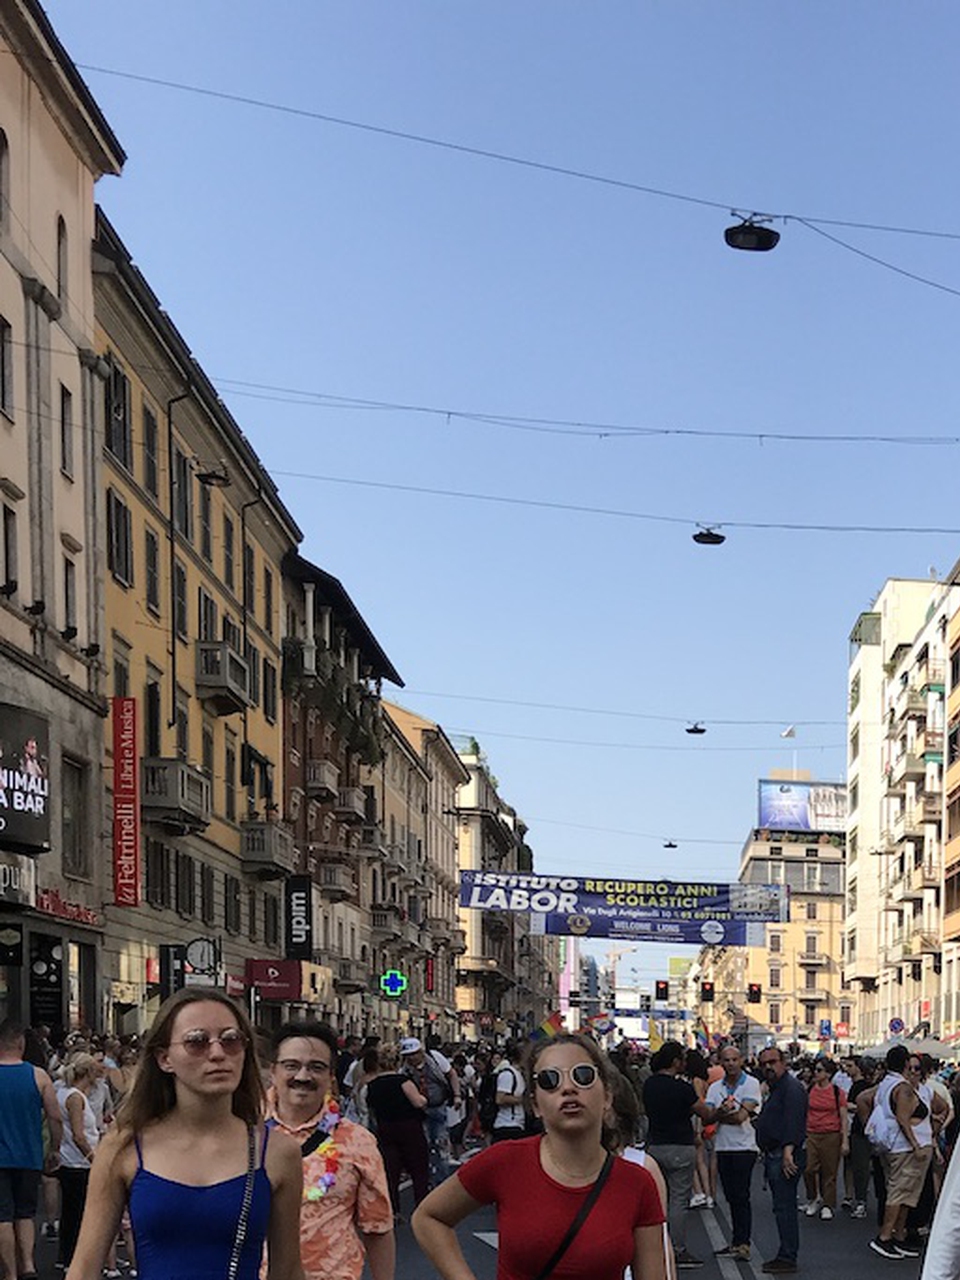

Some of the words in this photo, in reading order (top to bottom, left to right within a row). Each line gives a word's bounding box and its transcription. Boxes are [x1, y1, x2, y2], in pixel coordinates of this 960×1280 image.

[120, 700, 134, 746] Musica
[124, 754, 135, 763] e
[120, 764, 135, 789] Libri
[13, 791, 45, 814] BAR
[116, 803, 136, 884] Feltrinelli
[474, 873, 580, 891] ISTITUTO
[584, 880, 669, 895] RECUPERO
[674, 884, 718, 897] ANNI
[470, 886, 579, 914] LABOR
[582, 907, 597, 915] Via
[606, 893, 698, 908] SCOLASTICI
[291, 892, 311, 943] upim
